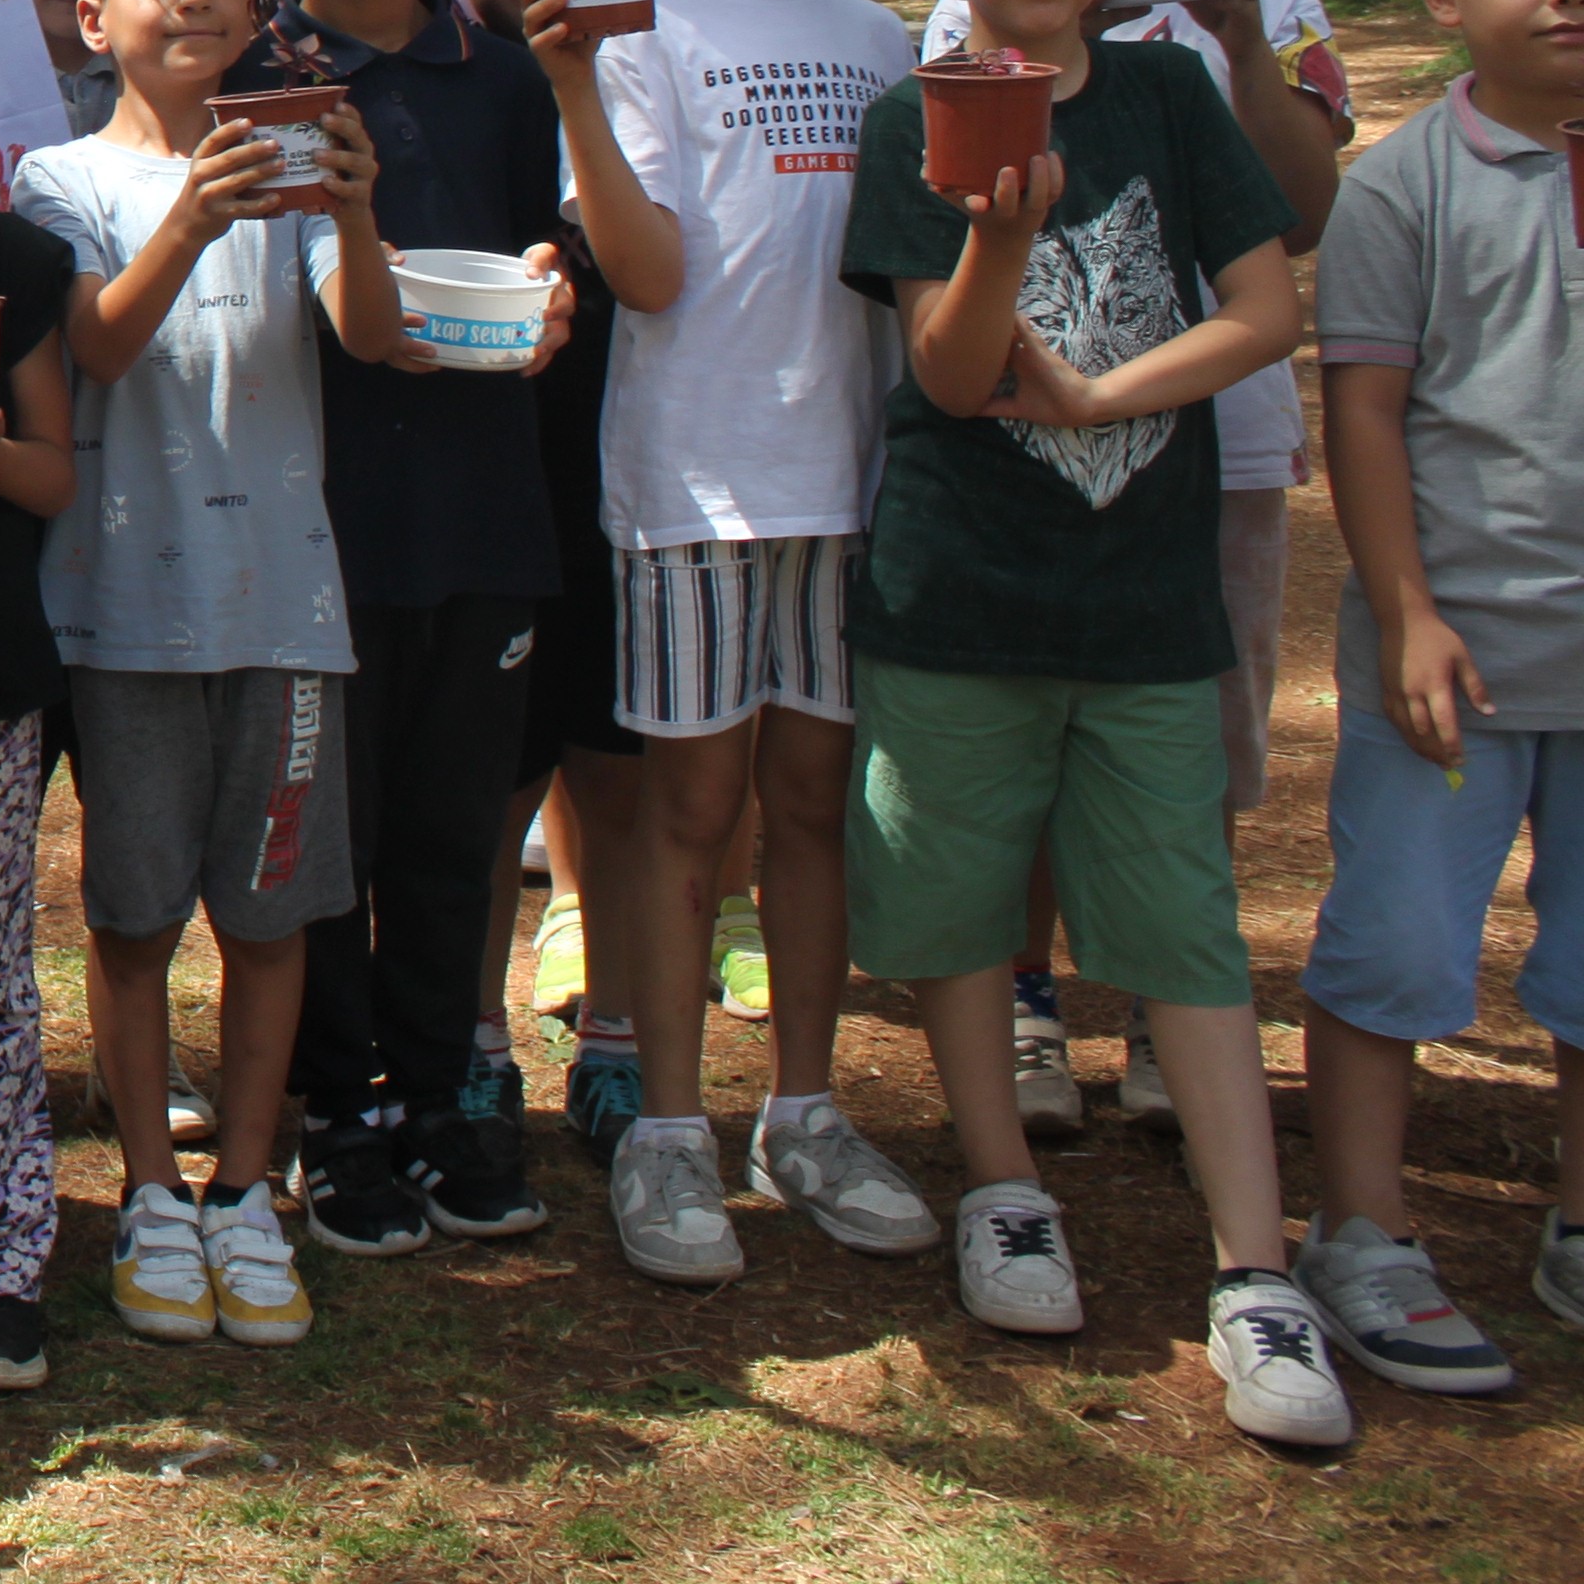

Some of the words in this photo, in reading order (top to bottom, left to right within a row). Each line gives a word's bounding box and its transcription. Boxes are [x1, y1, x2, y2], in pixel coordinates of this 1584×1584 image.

[784, 156, 828, 169] GAME
[197, 294, 249, 308] UNITED
[431, 318, 465, 341] kap
